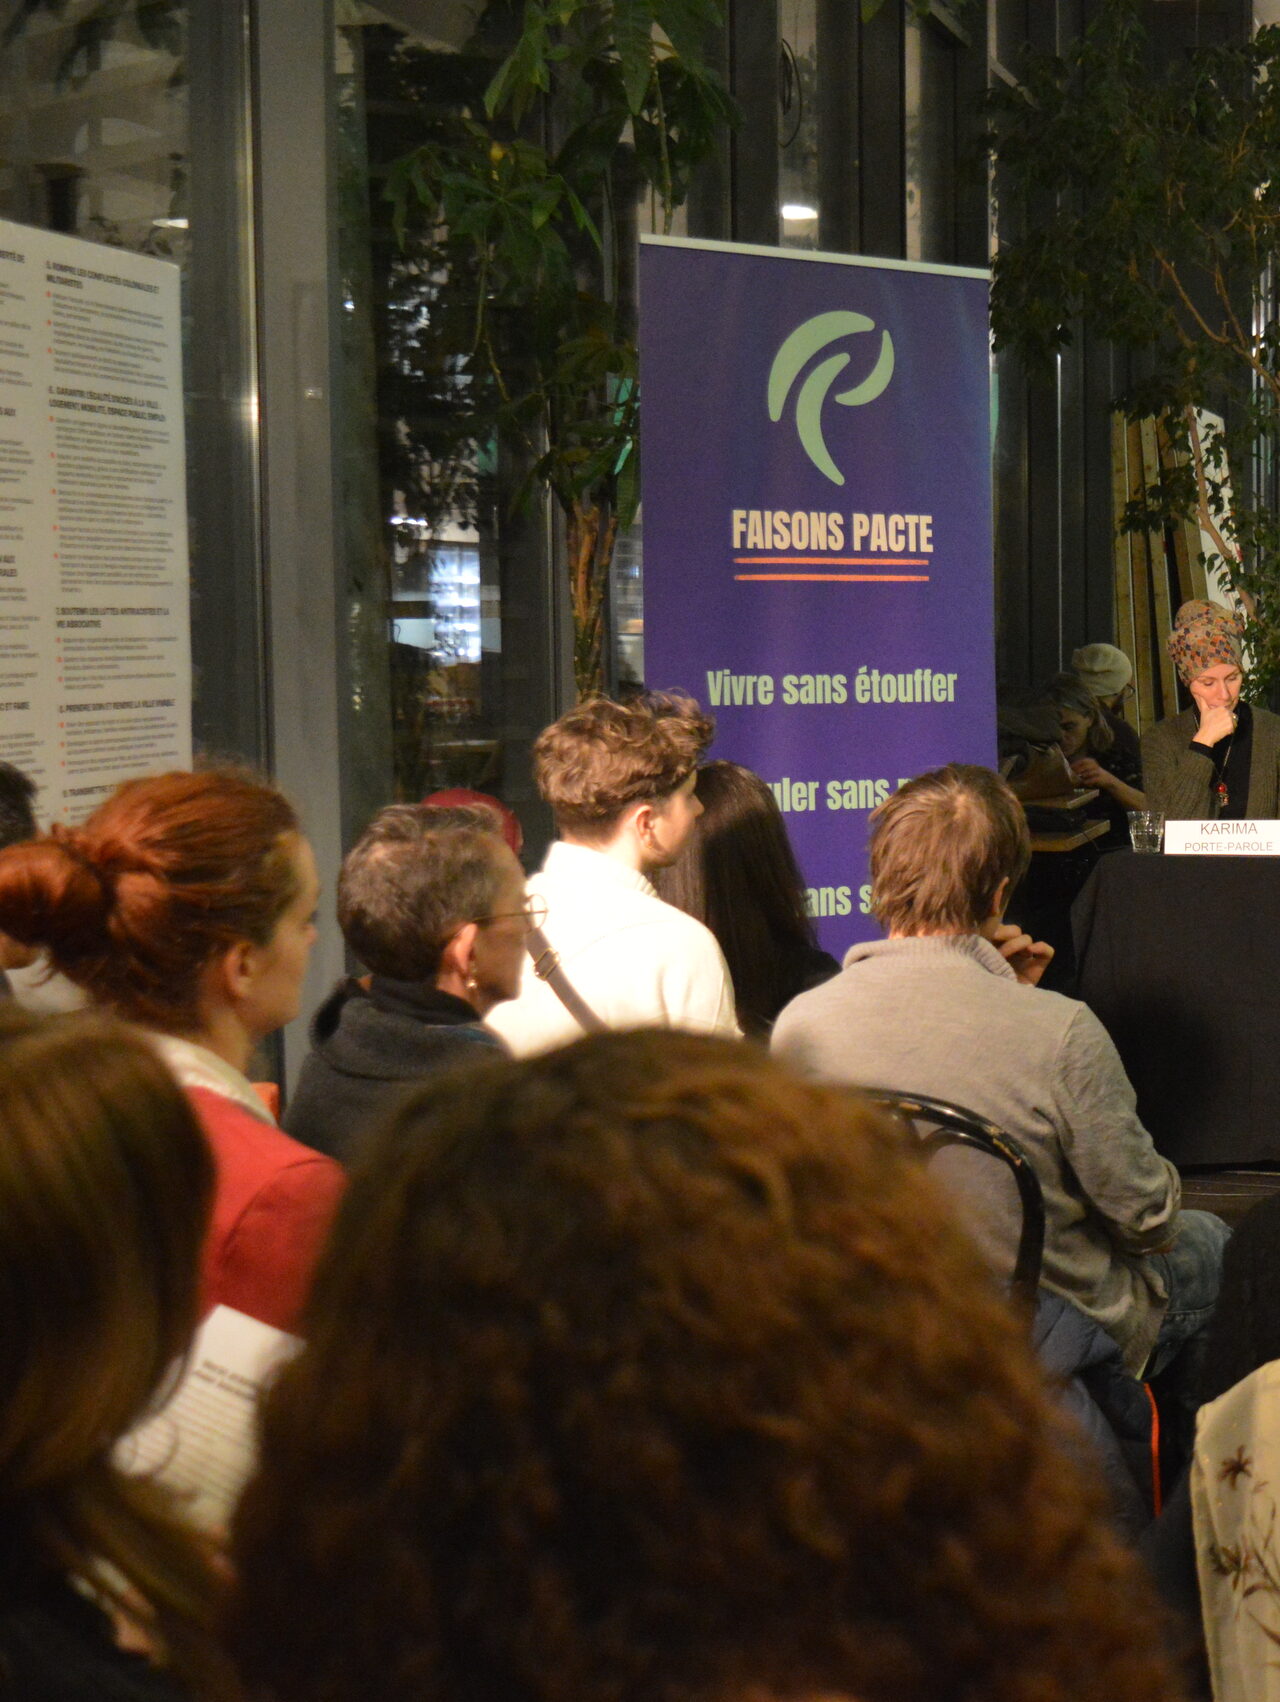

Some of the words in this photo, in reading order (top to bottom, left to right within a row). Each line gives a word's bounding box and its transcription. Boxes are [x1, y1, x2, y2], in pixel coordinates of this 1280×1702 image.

[732, 509, 845, 551] FAISONS
[852, 513, 934, 553] PACTE
[707, 669, 775, 706] Vivre
[782, 673, 848, 705] sans
[854, 665, 958, 704] étouffer
[826, 778, 892, 811] sans
[1200, 822, 1258, 835] KARIMA
[1184, 841, 1273, 852] PORTE-PAROLE
[806, 886, 852, 917] ans
